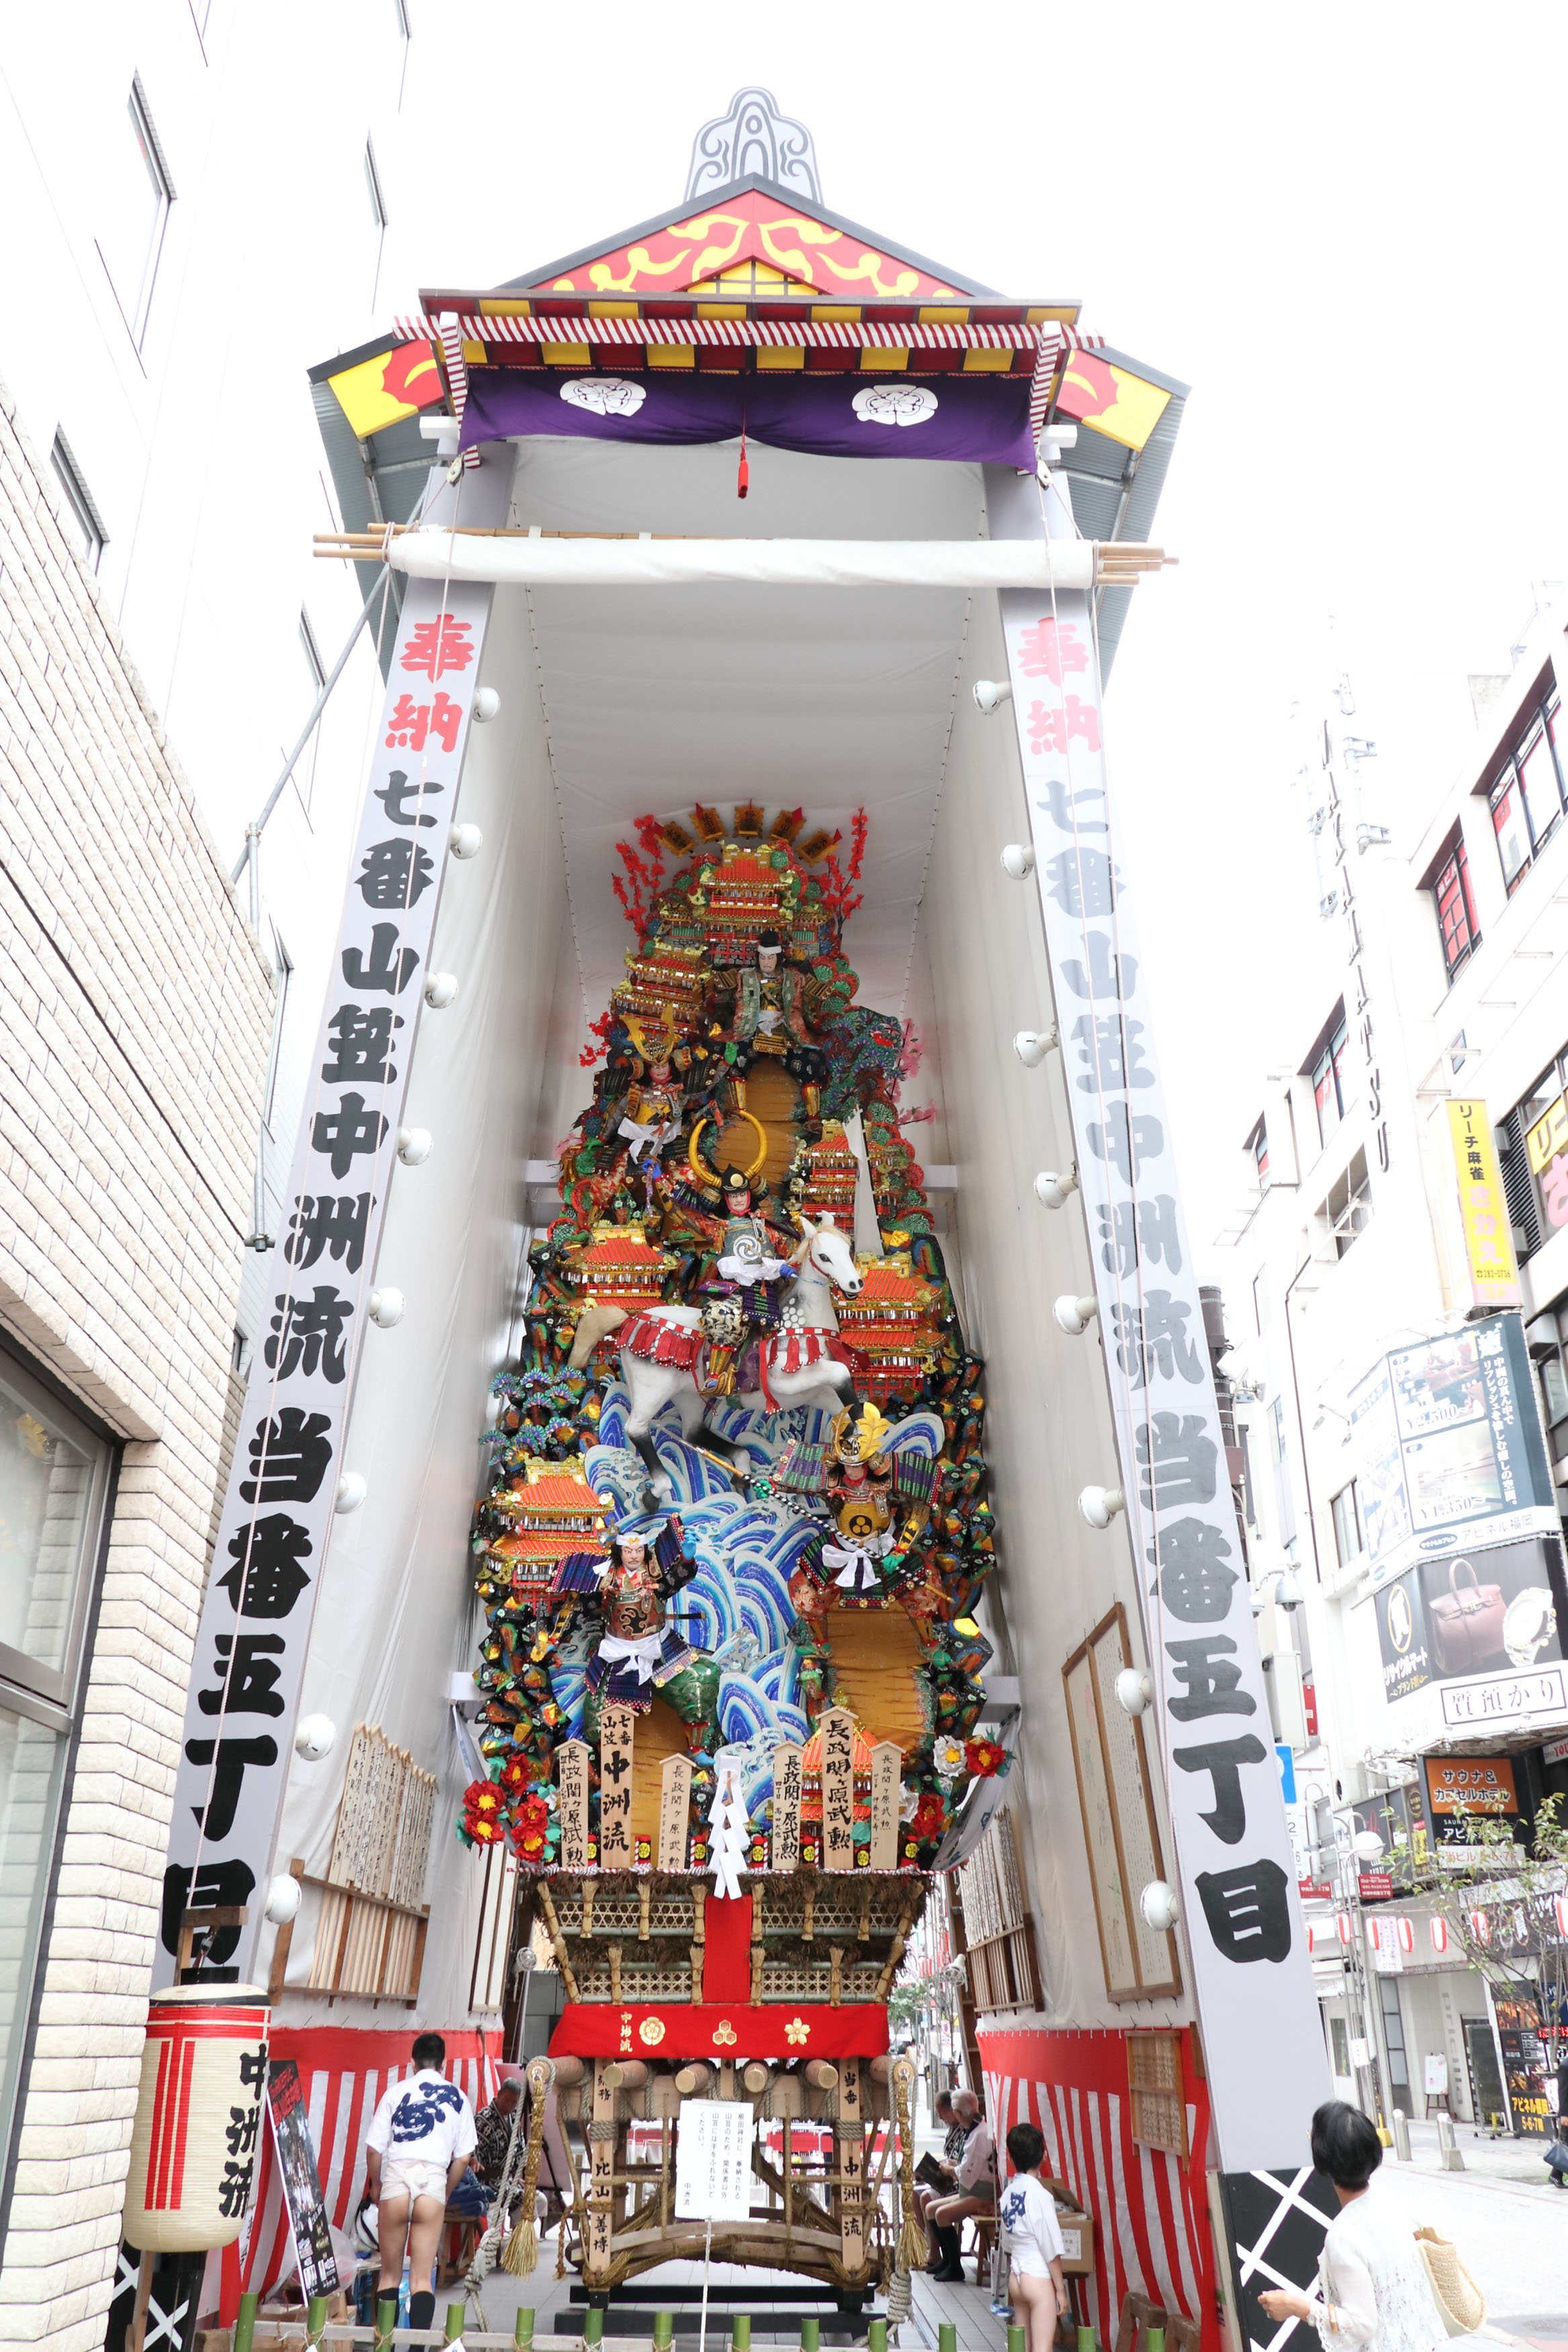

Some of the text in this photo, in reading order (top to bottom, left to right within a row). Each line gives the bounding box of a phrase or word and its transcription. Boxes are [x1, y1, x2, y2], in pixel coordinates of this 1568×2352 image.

[385, 614, 475, 752] 奉納
[1017, 616, 1100, 755] 奉納
[1460, 1105, 1485, 1180] リーチ麻雀
[1469, 1185, 1503, 1263] さかえ
[1493, 1357, 1514, 1424] 中洲の真ん中で
[1383, 1646, 1428, 1686] リサイクルマート
[603, 1751, 630, 1851] 中洲流
[844, 2072, 857, 2105] 当番
[844, 2156, 861, 2236] 中洲流
